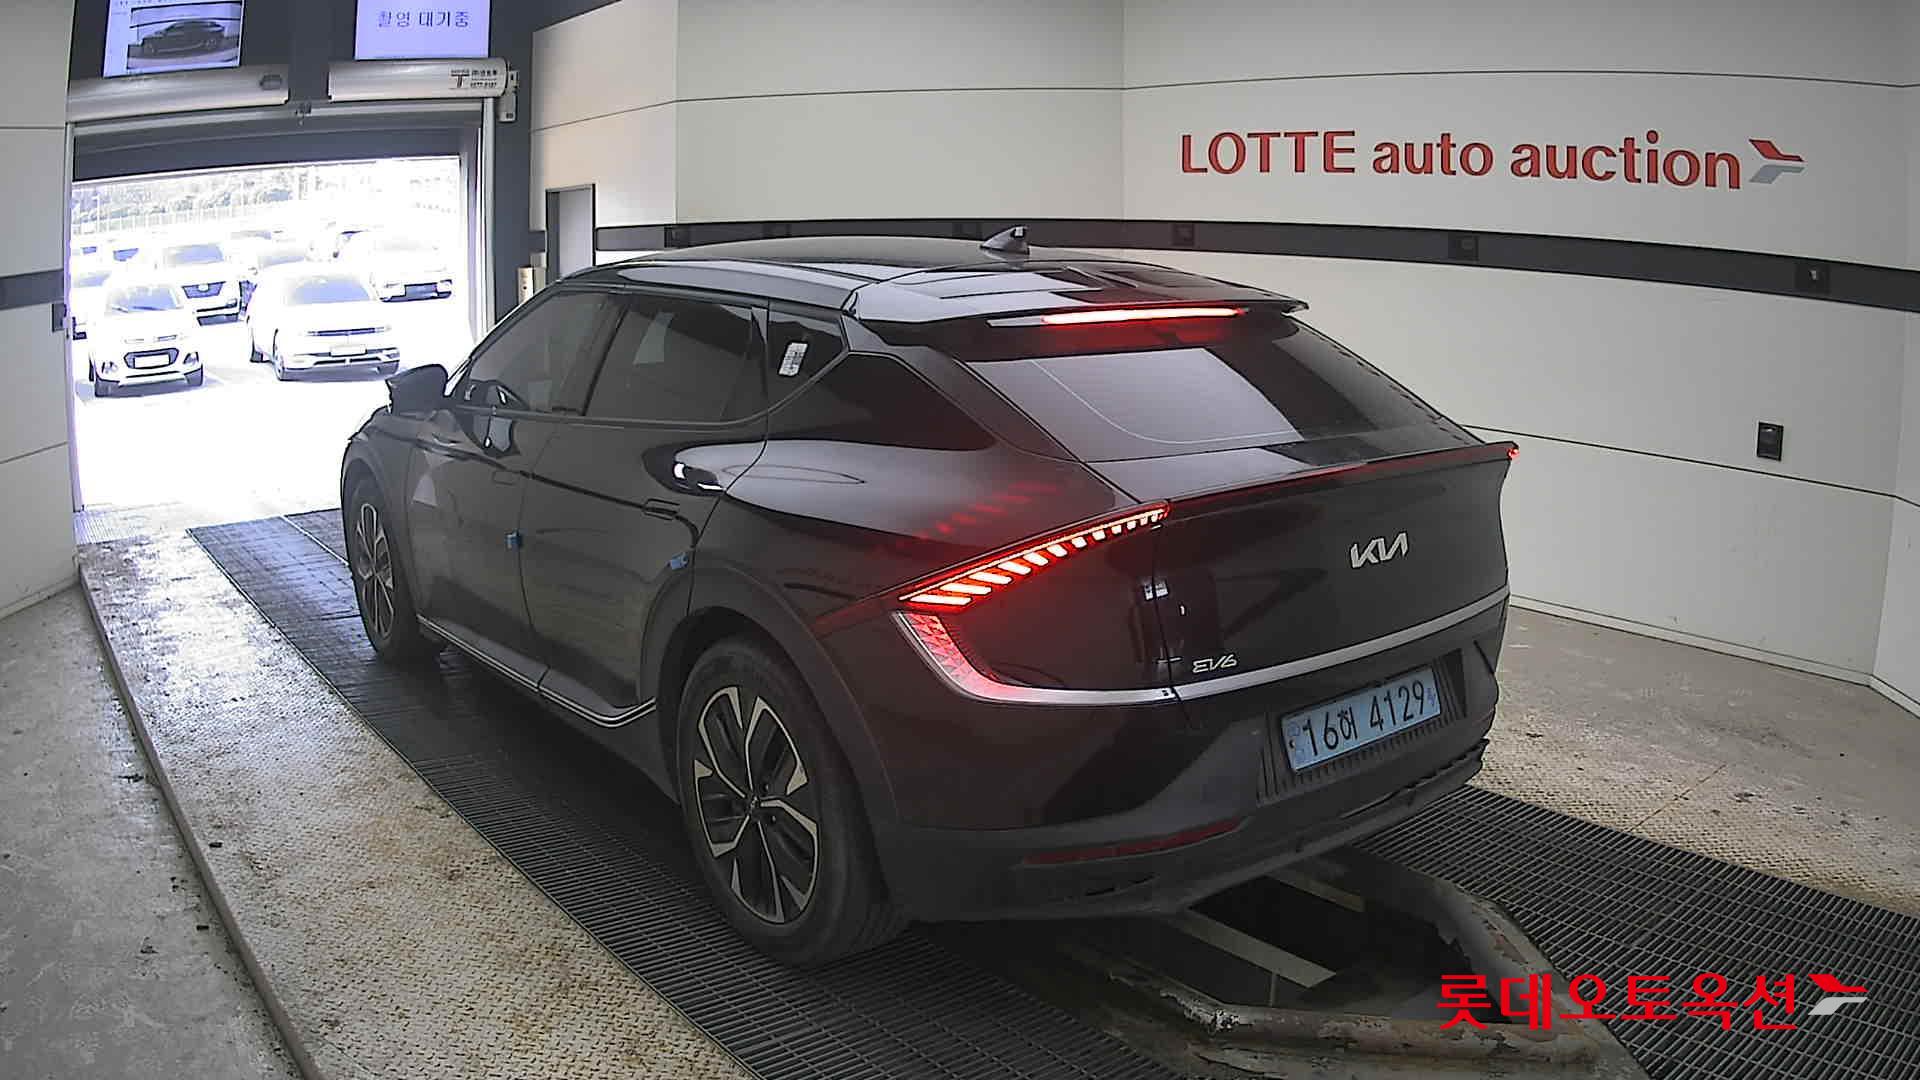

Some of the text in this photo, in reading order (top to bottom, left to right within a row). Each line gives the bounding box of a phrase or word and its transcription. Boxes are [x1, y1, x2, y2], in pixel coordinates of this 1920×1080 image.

[419, 11, 469, 28] 대기중
[1181, 129, 1742, 190] LOTTE auto auction
[1350, 532, 1409, 569] KIA
[1192, 653, 1238, 674] EV6
[1302, 679, 1425, 756] 16허 4129
